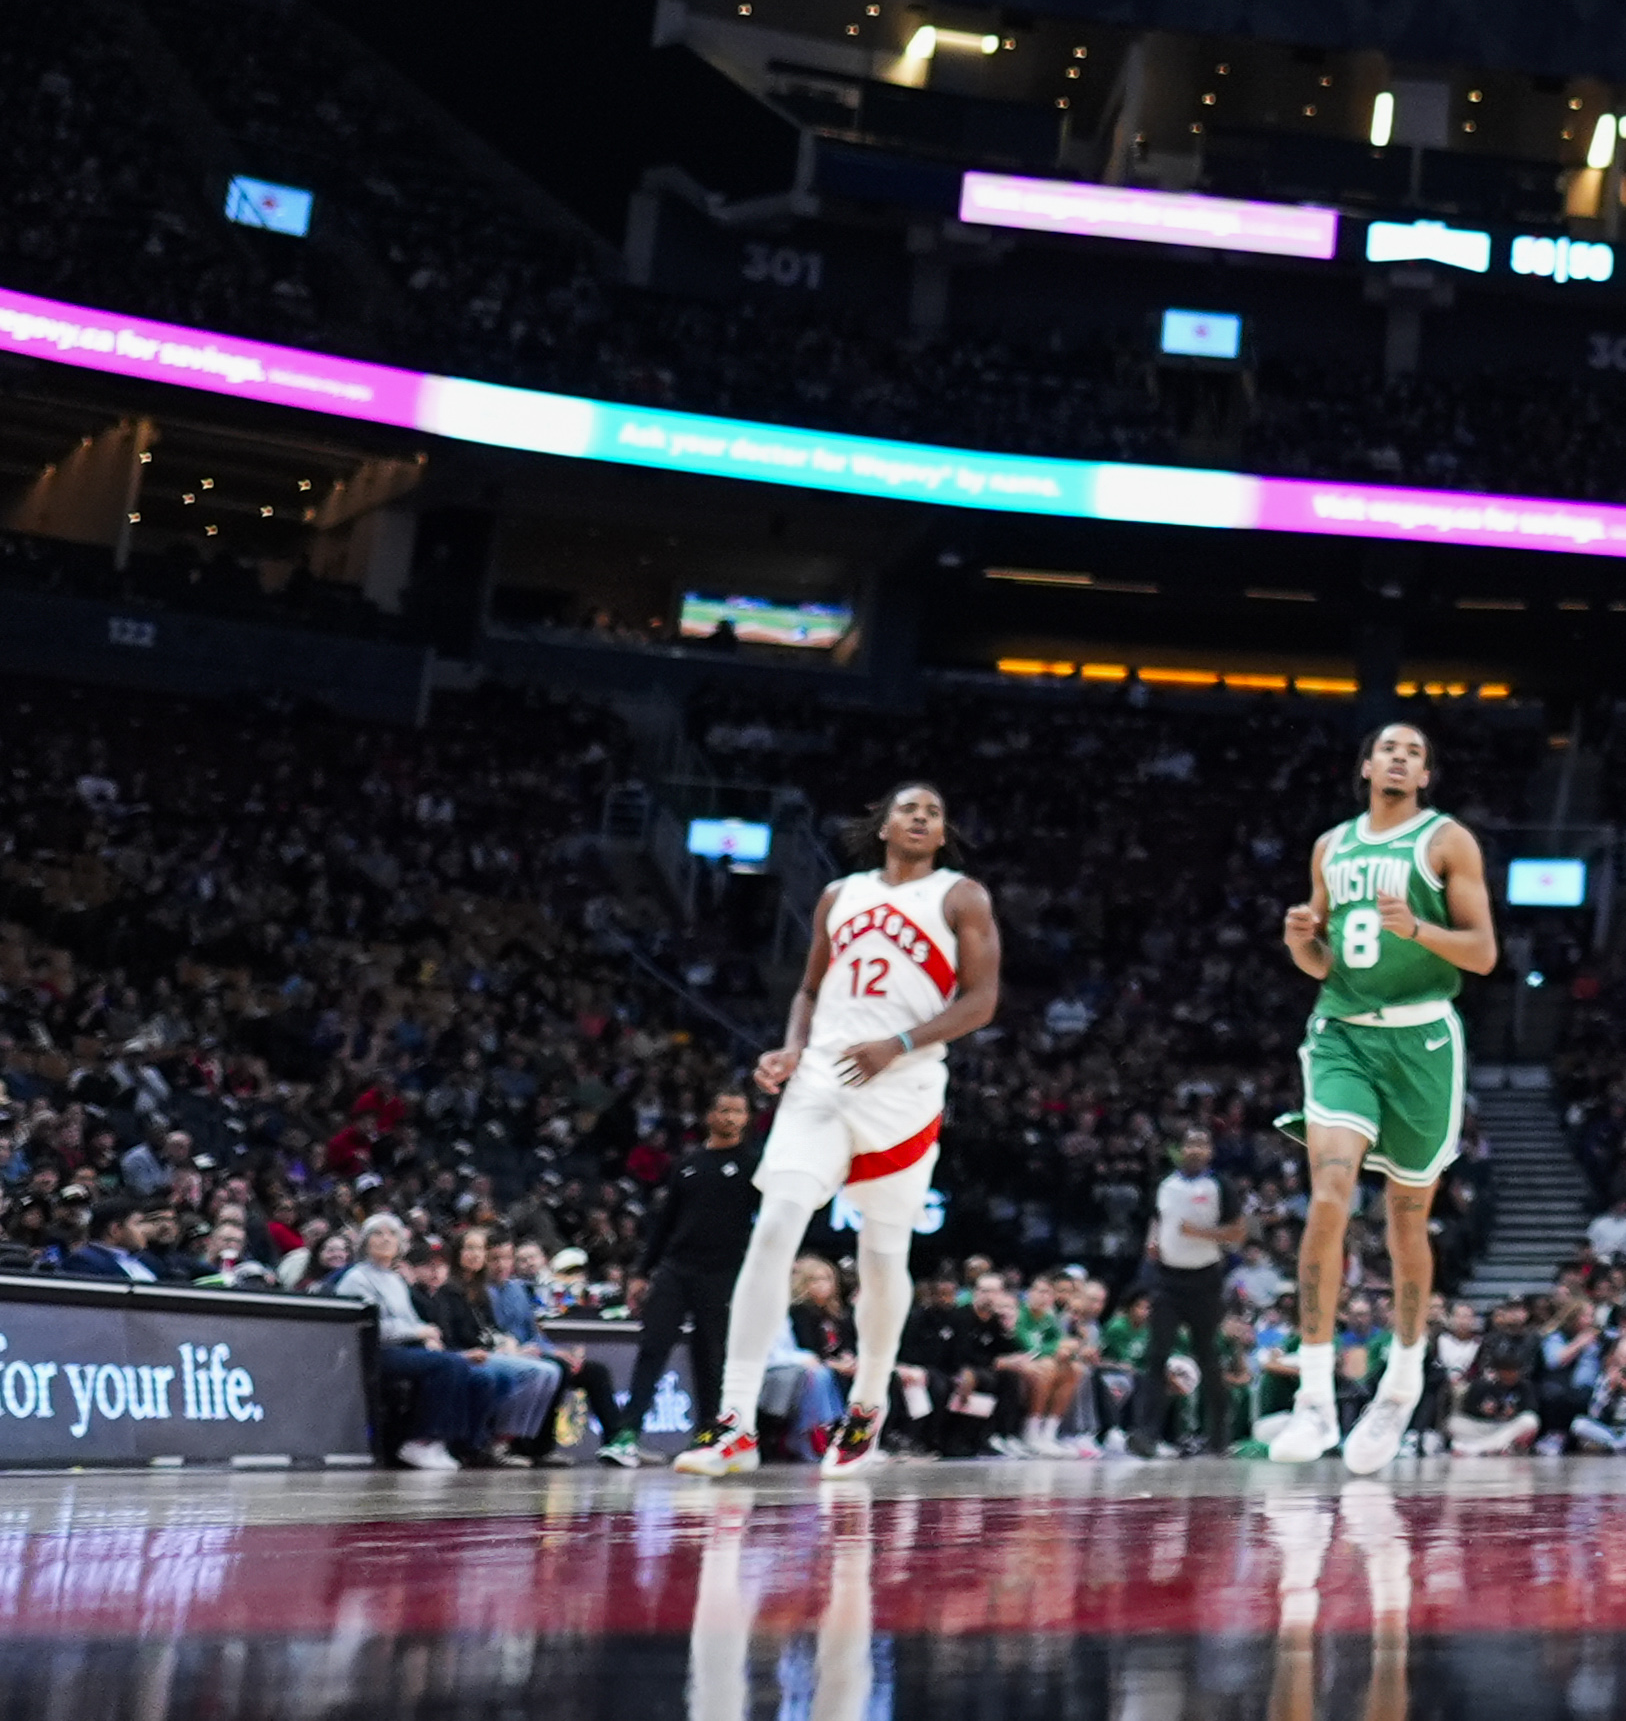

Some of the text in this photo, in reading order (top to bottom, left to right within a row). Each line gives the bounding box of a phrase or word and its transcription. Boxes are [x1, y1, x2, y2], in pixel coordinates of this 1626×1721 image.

[1342, 908, 1382, 969] 8
[848, 957, 891, 999] 12
[63, 1361, 175, 1439] your
[179, 1341, 265, 1423] life.
